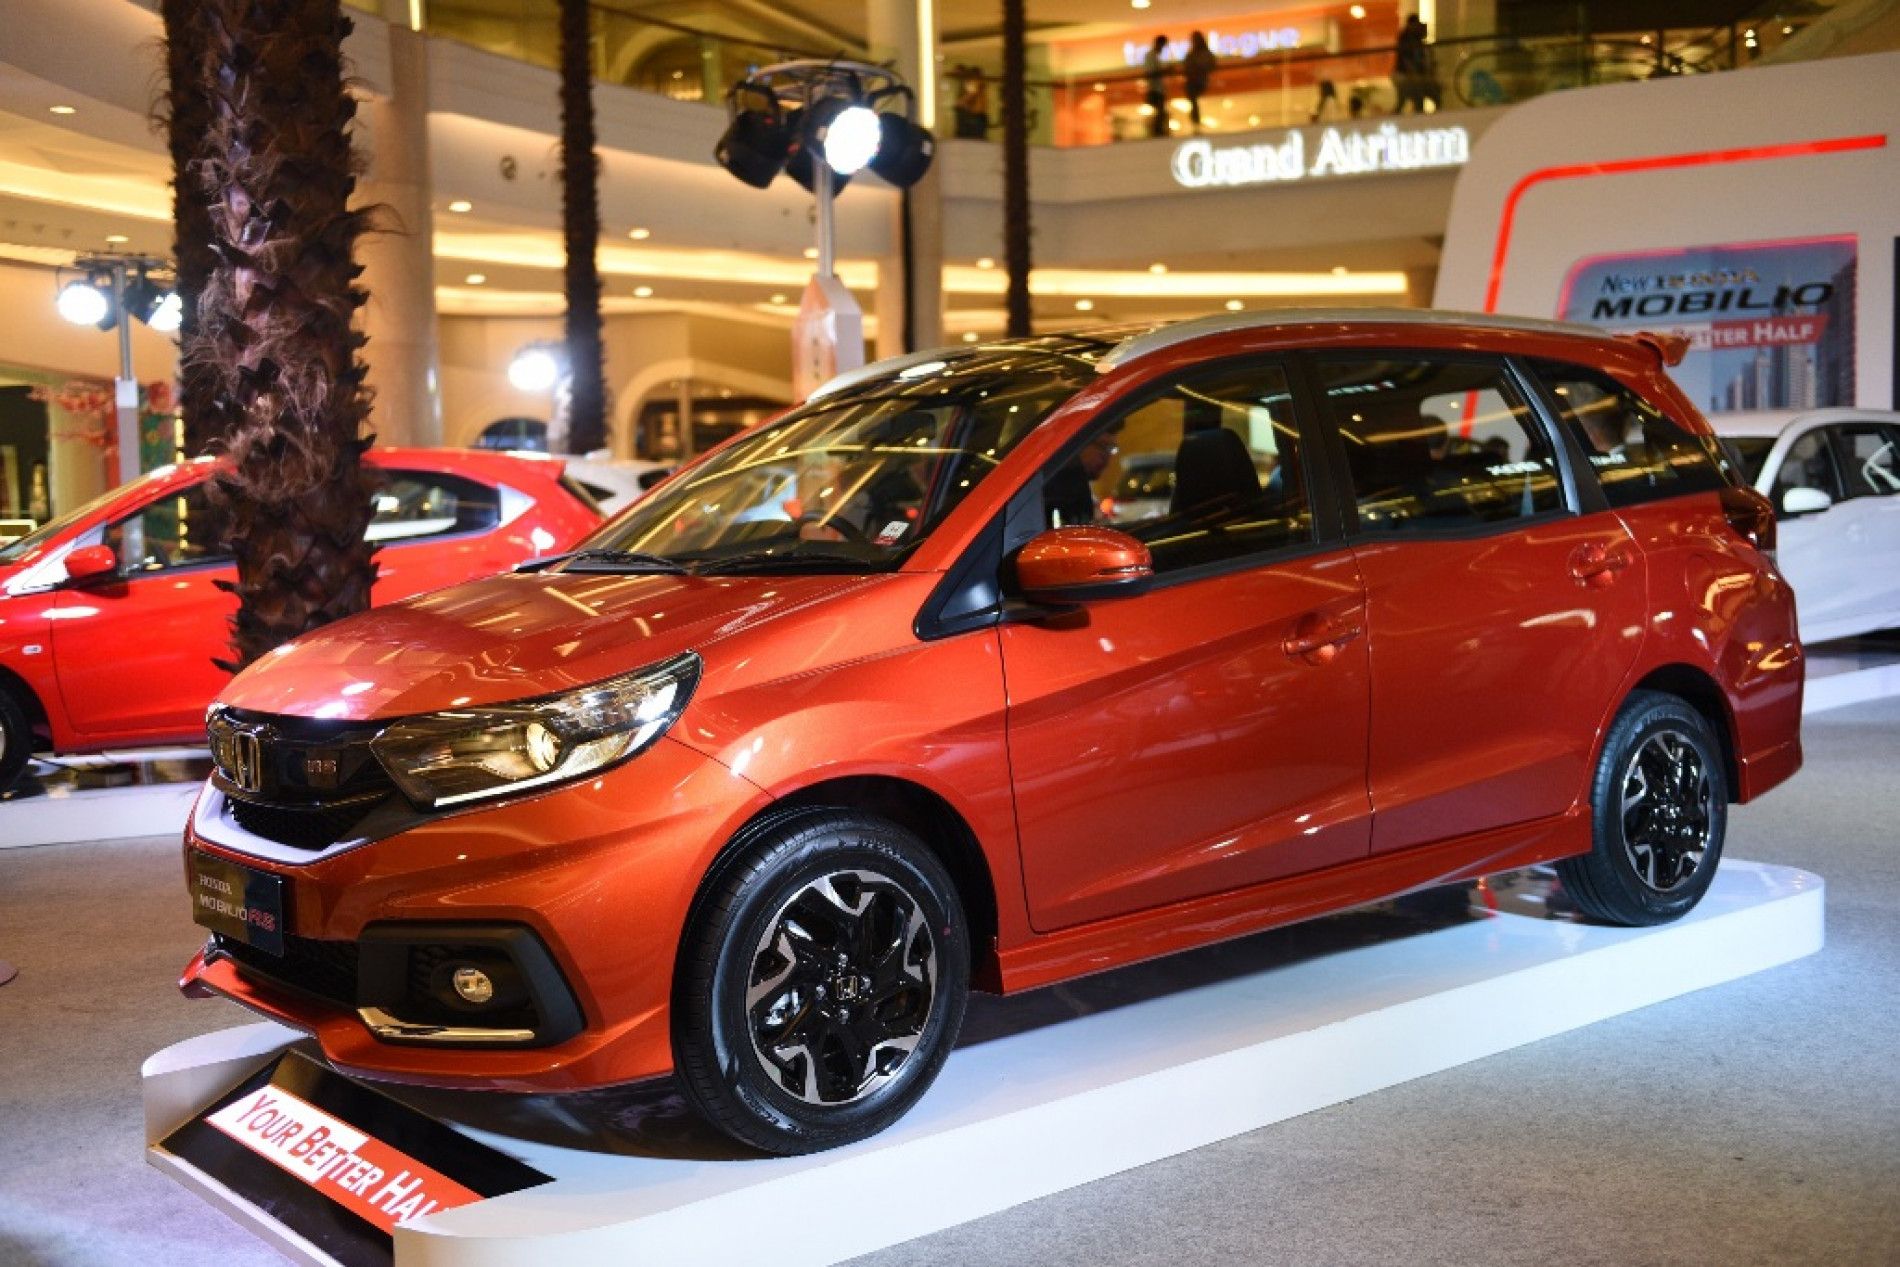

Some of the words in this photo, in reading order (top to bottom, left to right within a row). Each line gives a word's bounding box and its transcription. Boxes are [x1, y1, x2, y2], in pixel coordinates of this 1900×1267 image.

[1172, 129, 1304, 187] Grand
[1309, 124, 1469, 177] Atrium
[1592, 282, 1835, 320] MOBILIO
[1600, 274, 1647, 293] New
[1752, 321, 1815, 344] HALF
[235, 1093, 304, 1148] YOUR
[288, 1125, 385, 1197] BETTER
[367, 1168, 449, 1223] HAL
